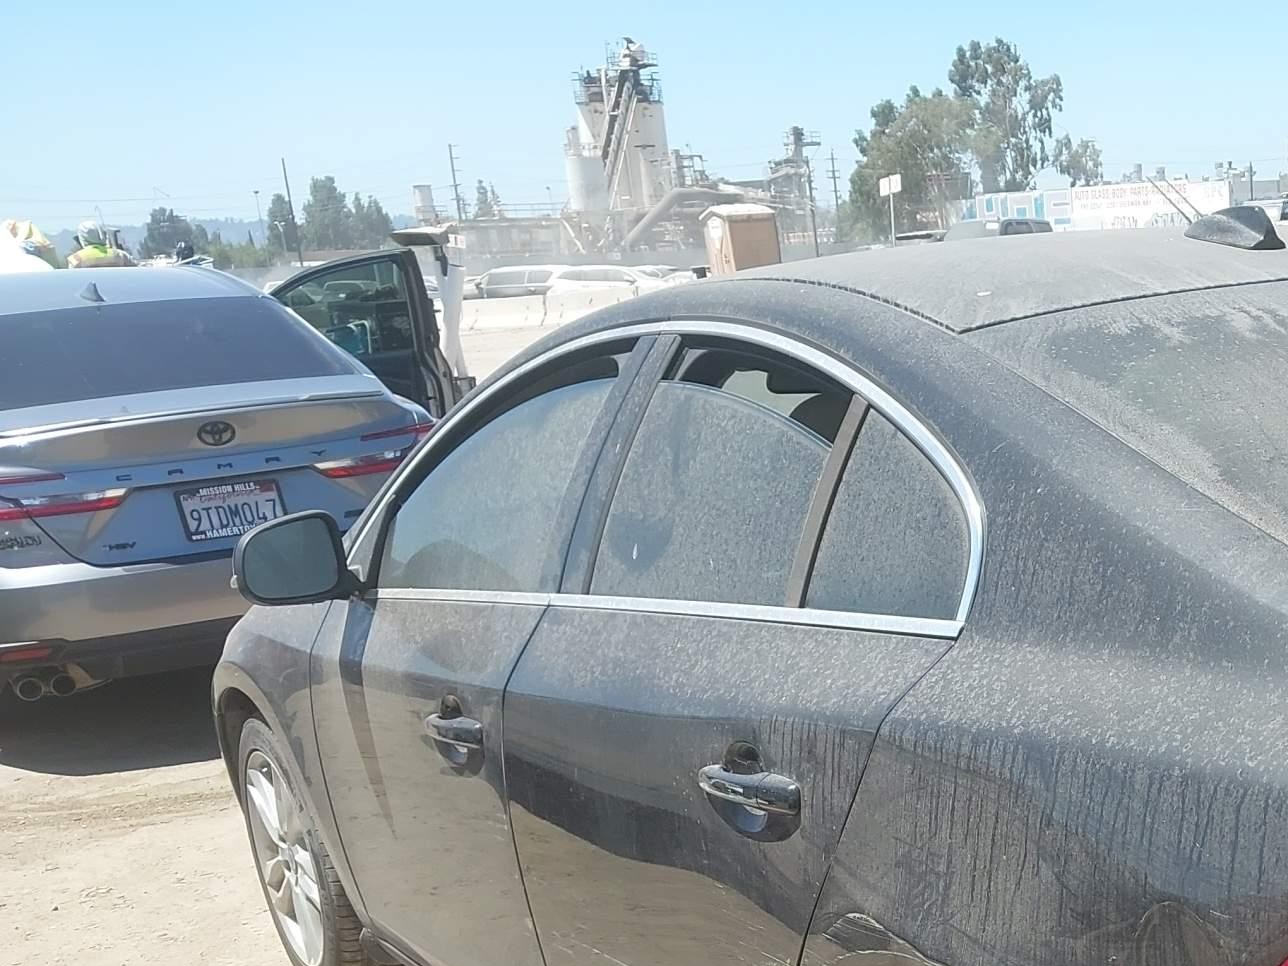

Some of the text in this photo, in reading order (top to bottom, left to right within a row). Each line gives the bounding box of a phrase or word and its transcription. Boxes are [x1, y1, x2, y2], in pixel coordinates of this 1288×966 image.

[116, 449, 326, 482] CAMRY
[198, 482, 255, 497] MISSION HILLS
